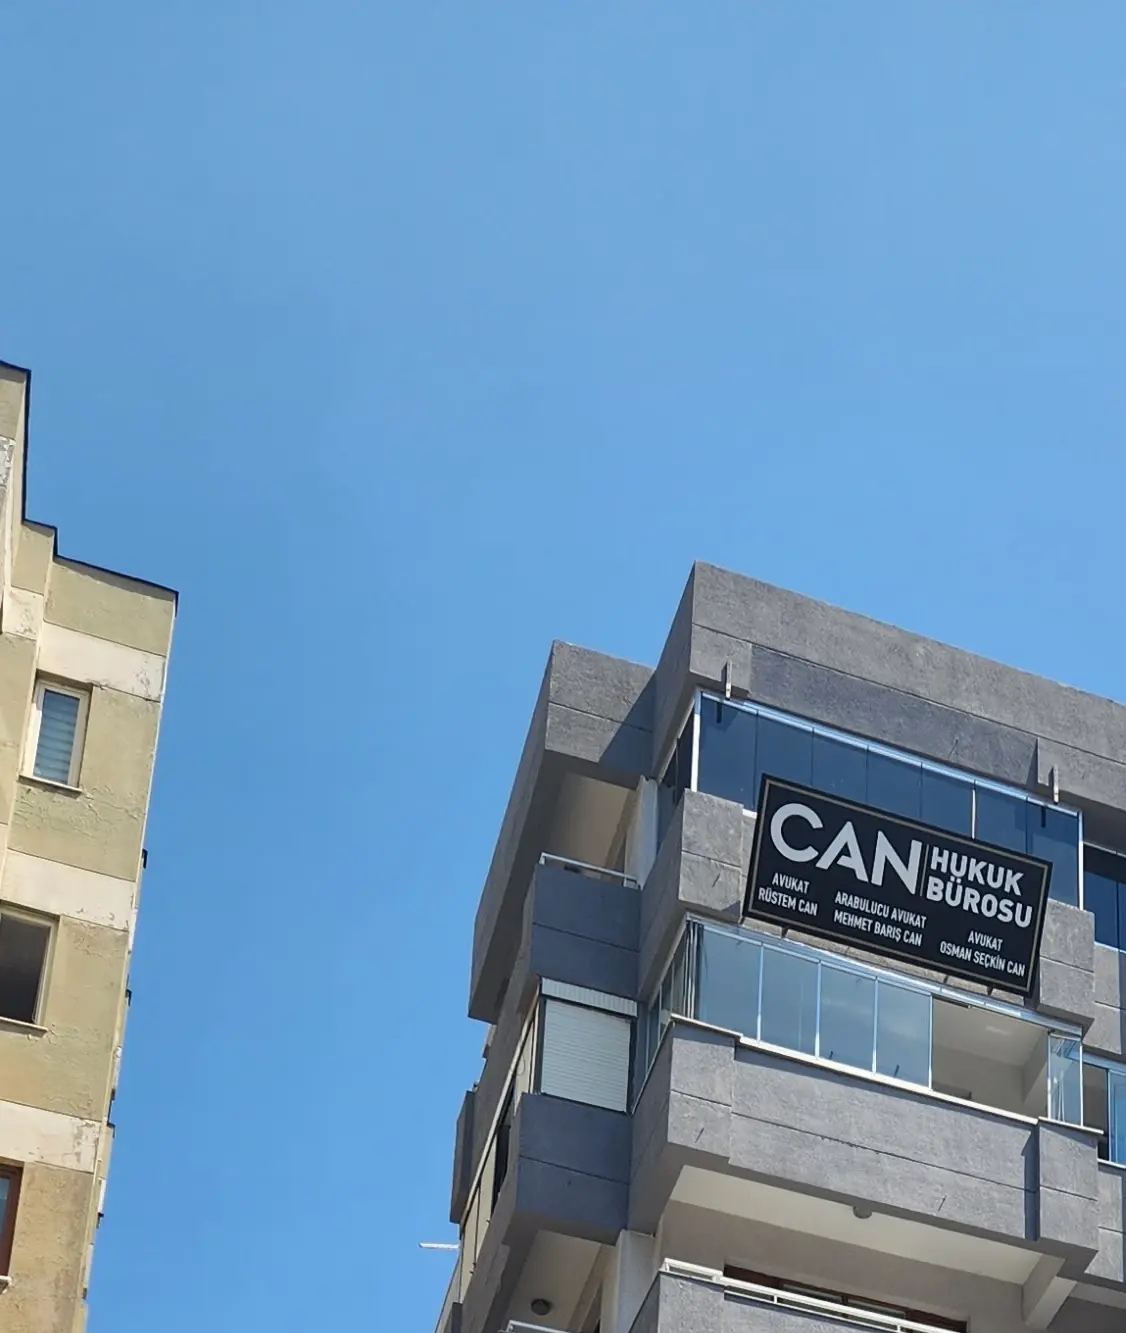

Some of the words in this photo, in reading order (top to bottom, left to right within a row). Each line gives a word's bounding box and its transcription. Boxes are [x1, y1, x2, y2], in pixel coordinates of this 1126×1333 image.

[770, 803, 923, 895] CAN
[772, 872, 810, 894] AVUKAT
[931, 847, 1024, 896] HUKUK
[758, 886, 796, 911] RÜSTEM
[798, 898, 818, 917] CAN
[835, 891, 889, 919] ARABULUCU
[891, 907, 927, 929] AVUKAT
[926, 876, 1032, 928] BÜROSU
[834, 910, 872, 933] MEHMET
[874, 921, 901, 943] BARIŞ
[903, 929, 923, 947] CAN
[967, 930, 1003, 952] AVUKAT
[940, 941, 972, 963] OSMAN
[973, 950, 1005, 972] SEÇKİN
[1006, 957, 1026, 977] CAN
